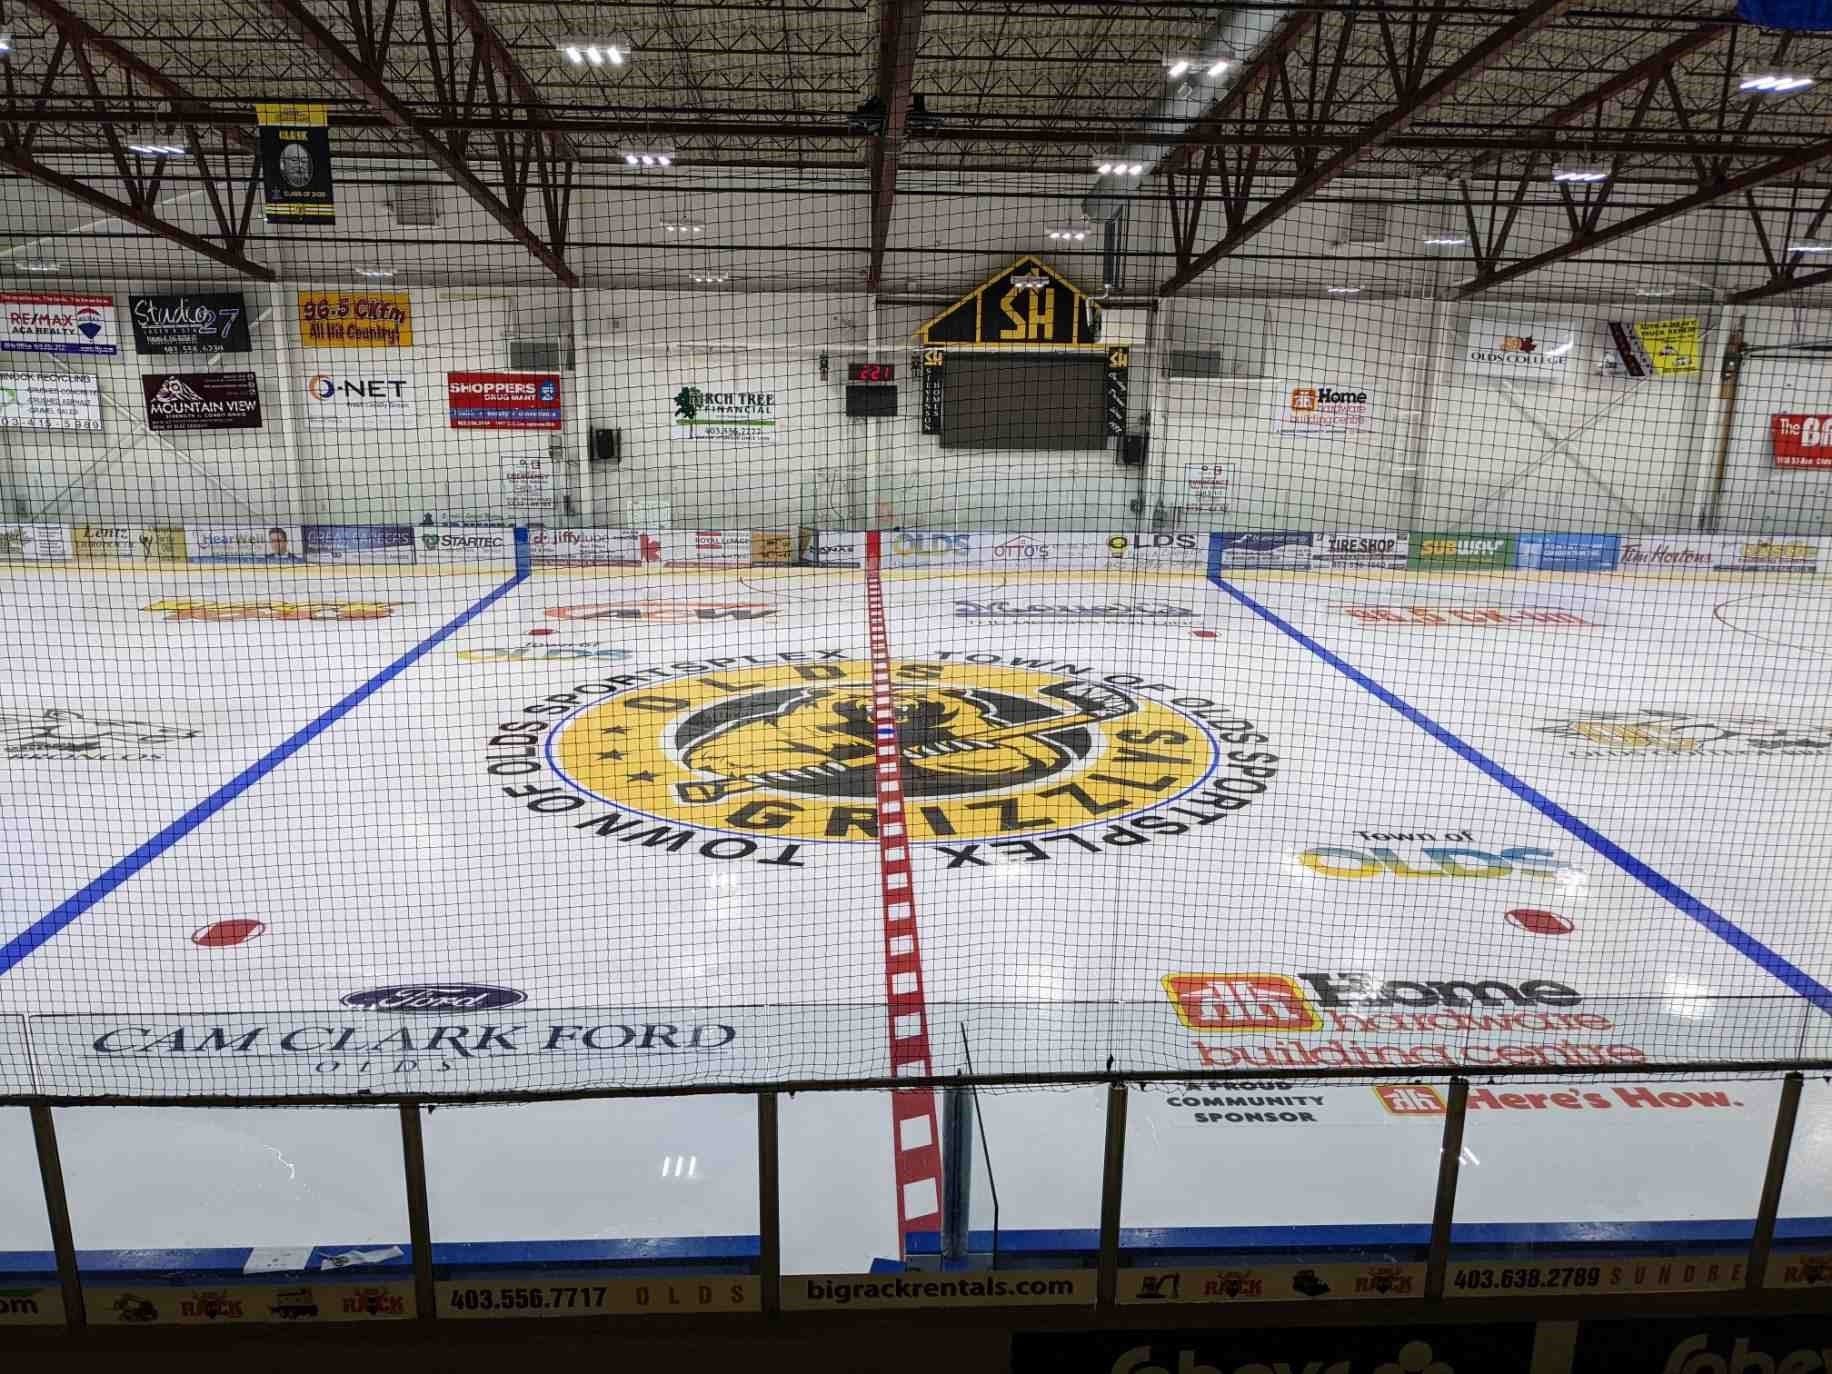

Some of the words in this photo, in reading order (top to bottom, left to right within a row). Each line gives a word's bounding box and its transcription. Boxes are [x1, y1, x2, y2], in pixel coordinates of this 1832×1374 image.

[9, 311, 73, 327] RE/MAX
[134, 297, 208, 326] Studio
[199, 308, 240, 339] 27
[304, 297, 350, 321] 96.5
[1000, 287, 1055, 340] SH
[35, 326, 75, 336] REALTY
[450, 383, 537, 395] SHOPPERS
[737, 393, 774, 406] TREE
[1317, 388, 1368, 404] Home
[150, 401, 224, 415] MOUNTAIN
[226, 400, 257, 413] VIEW
[704, 405, 772, 415] FINANCIAL
[1780, 417, 1801, 436] The
[441, 534, 504, 548] STARTEC
[993, 545, 1049, 558] OTTO'S
[1109, 534, 1196, 549] OLDS
[1328, 540, 1360, 553] TIRE
[1360, 539, 1395, 553] SHOP
[1422, 539, 1505, 556] SUBWAY
[1620, 544, 1649, 563] Tim
[1650, 545, 1713, 564] Hortons
[934, 651, 1095, 676] TOWN
[522, 648, 850, 717] SPORTSPLEX
[1102, 674, 1178, 694] OF
[1171, 696, 1270, 747] OLDS
[486, 719, 549, 777] OLDS
[725, 729, 1193, 837] GRIZZLYS
[502, 783, 586, 814] OF
[934, 749, 1280, 870] SPORTSPLEX
[574, 812, 806, 867] TOWN
[1351, 830, 1434, 842] Town
[1449, 830, 1476, 842] of
[1299, 847, 1572, 878] OLDS
[377, 987, 490, 1009] Ford
[1296, 971, 1585, 1008] Home
[1329, 1006, 1616, 1033] hardware
[91, 1025, 266, 1055] CAM
[279, 1023, 520, 1059] CLARK
[540, 1023, 736, 1052] FORD
[1191, 1040, 1466, 1067] building
[1470, 1041, 1647, 1065] centre
[315, 1059, 455, 1073] OLDS
[1167, 1095, 1326, 1107] COMMUNITY
[1466, 1087, 1613, 1110] Here's
[1611, 1086, 1745, 1109] How.
[1194, 1111, 1319, 1123] SPONSOR
[1454, 1267, 1601, 1290] 403.638.2789
[450, 1286, 608, 1310] 403.556.7717
[806, 1277, 1074, 1303] bigrackrentals.com
